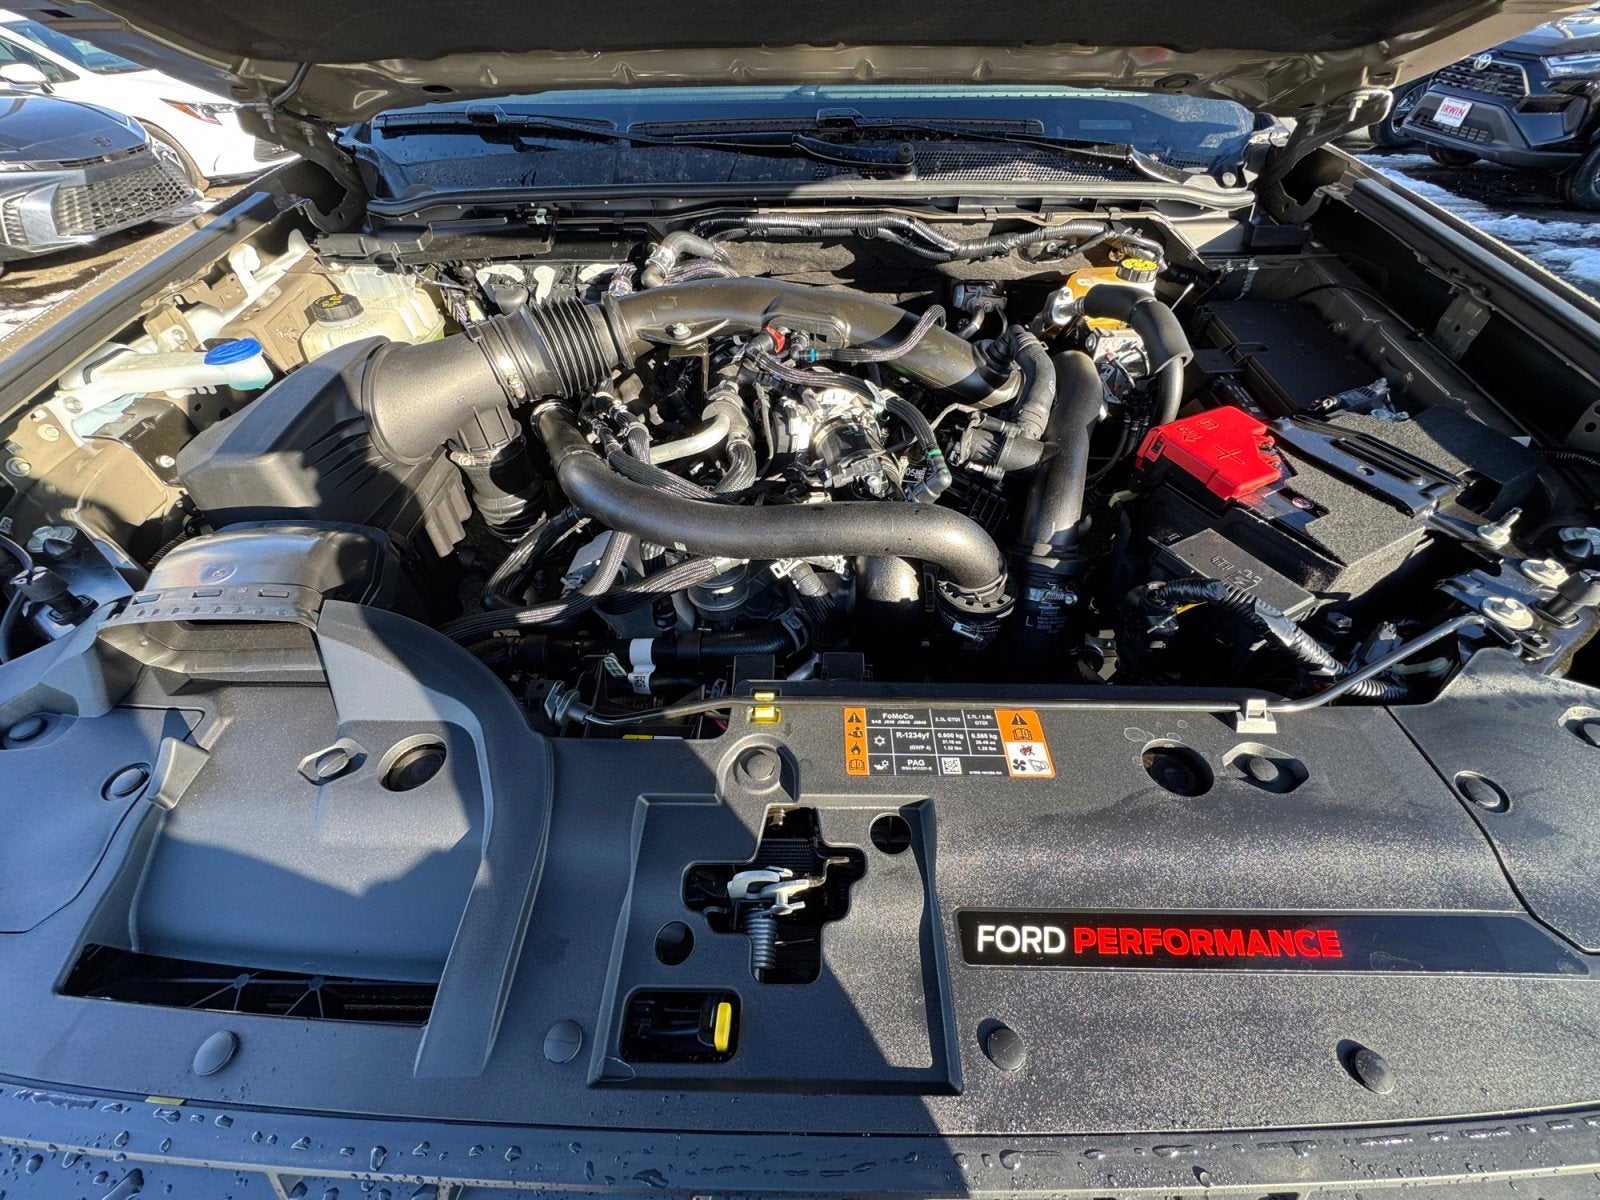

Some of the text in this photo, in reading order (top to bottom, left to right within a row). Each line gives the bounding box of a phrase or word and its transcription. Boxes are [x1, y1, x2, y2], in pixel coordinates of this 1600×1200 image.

[1440, 103, 1466, 117] IRWIN
[896, 731, 930, 740] R-1234yf
[977, 925, 1342, 959] FORD PERFORMANCE
